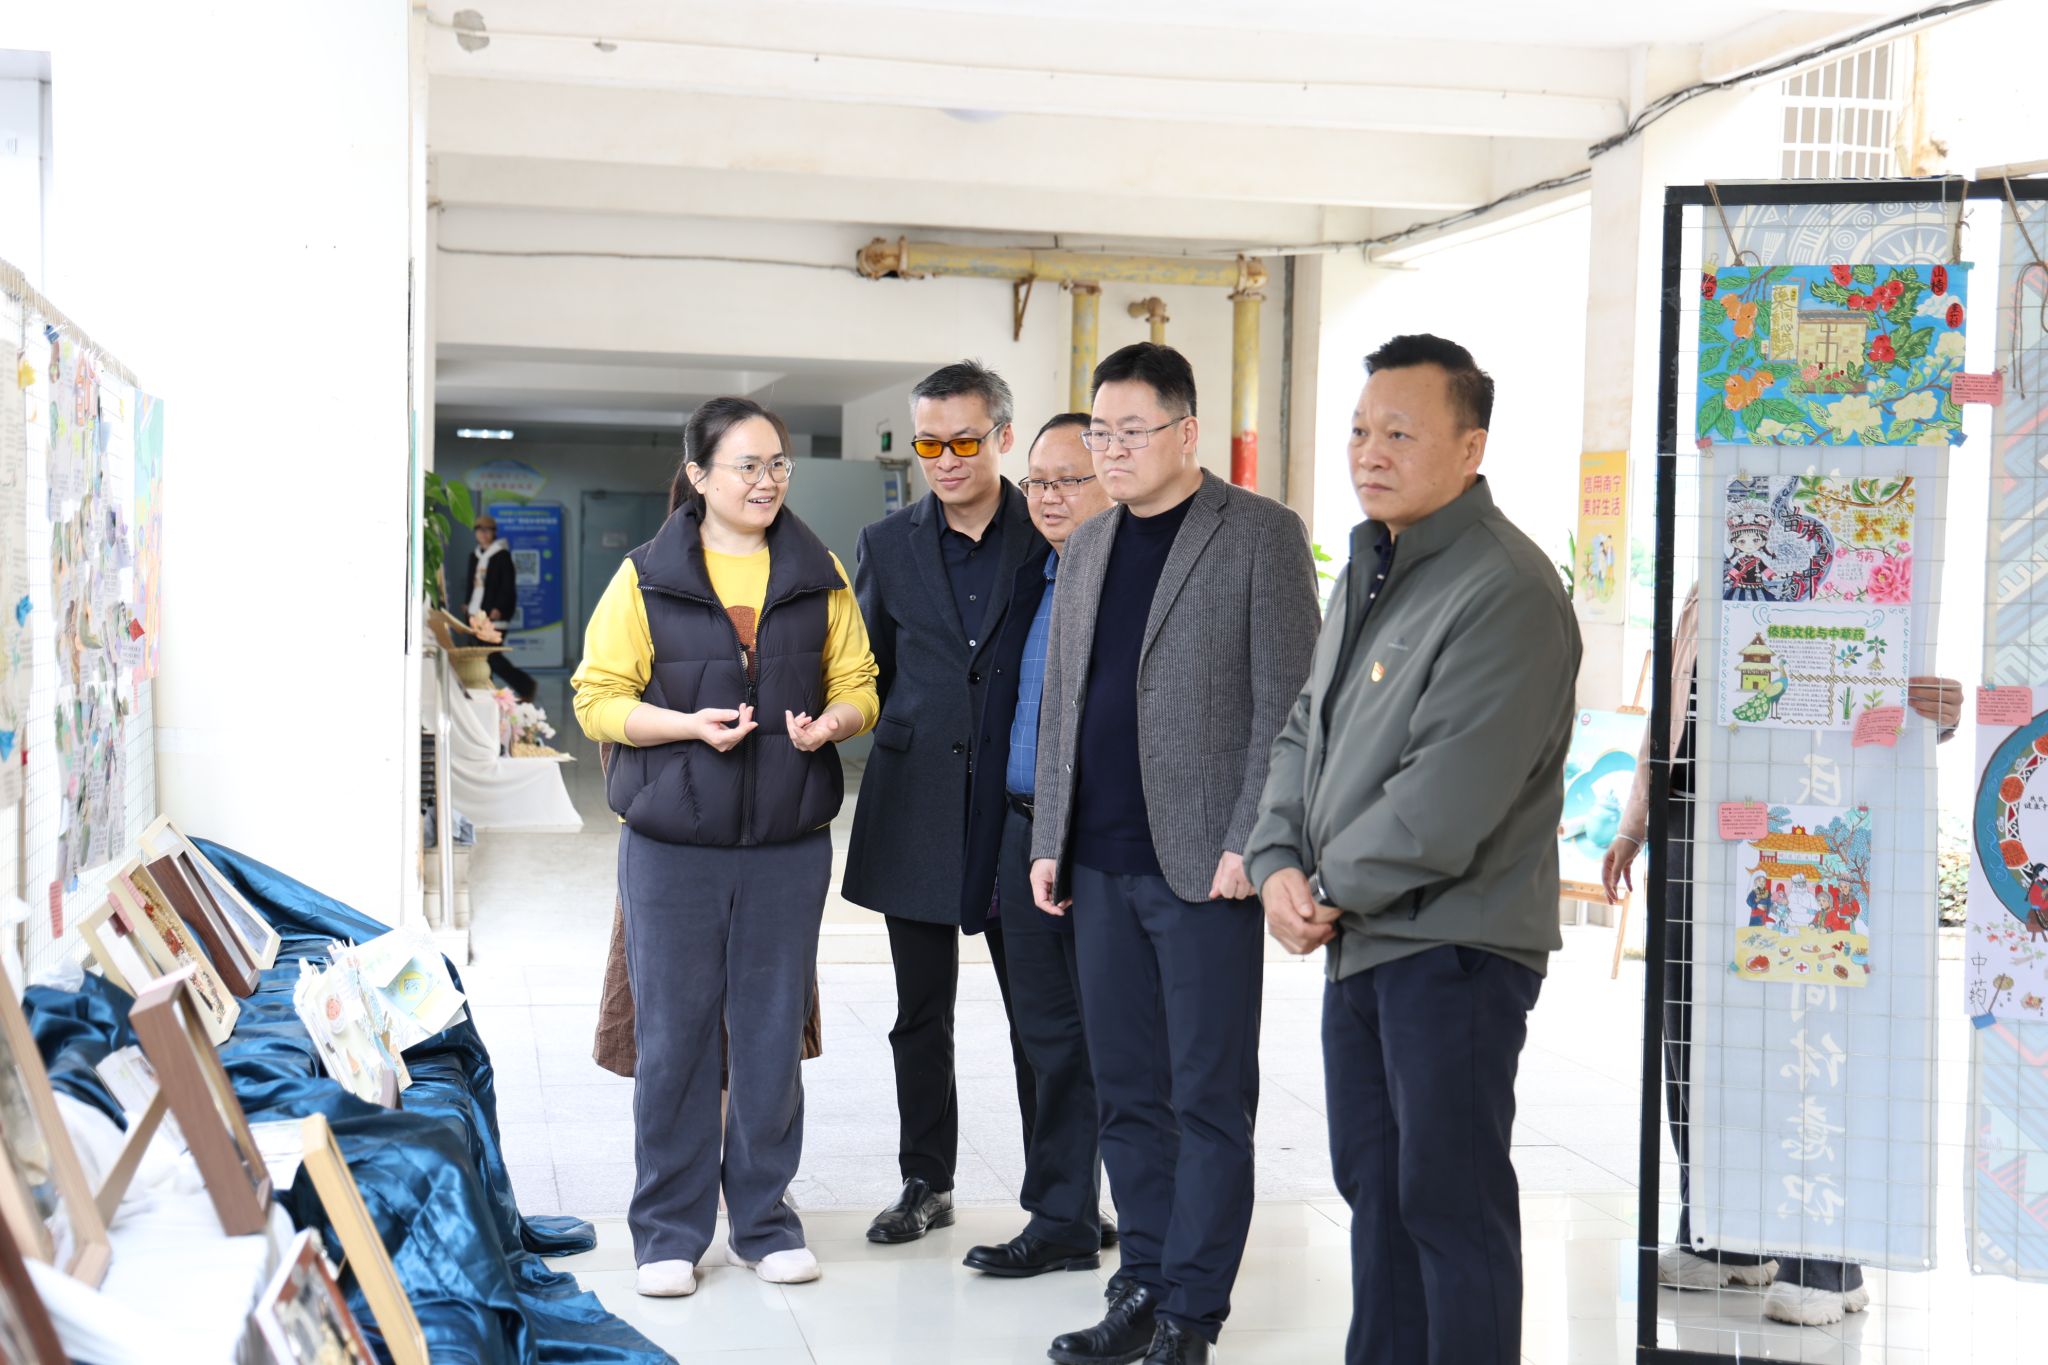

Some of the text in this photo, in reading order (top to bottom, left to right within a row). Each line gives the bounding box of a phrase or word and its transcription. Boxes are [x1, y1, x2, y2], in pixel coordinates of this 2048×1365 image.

[1583, 475, 1621, 494] 信用南宁
[1583, 497, 1621, 516] 美好生活
